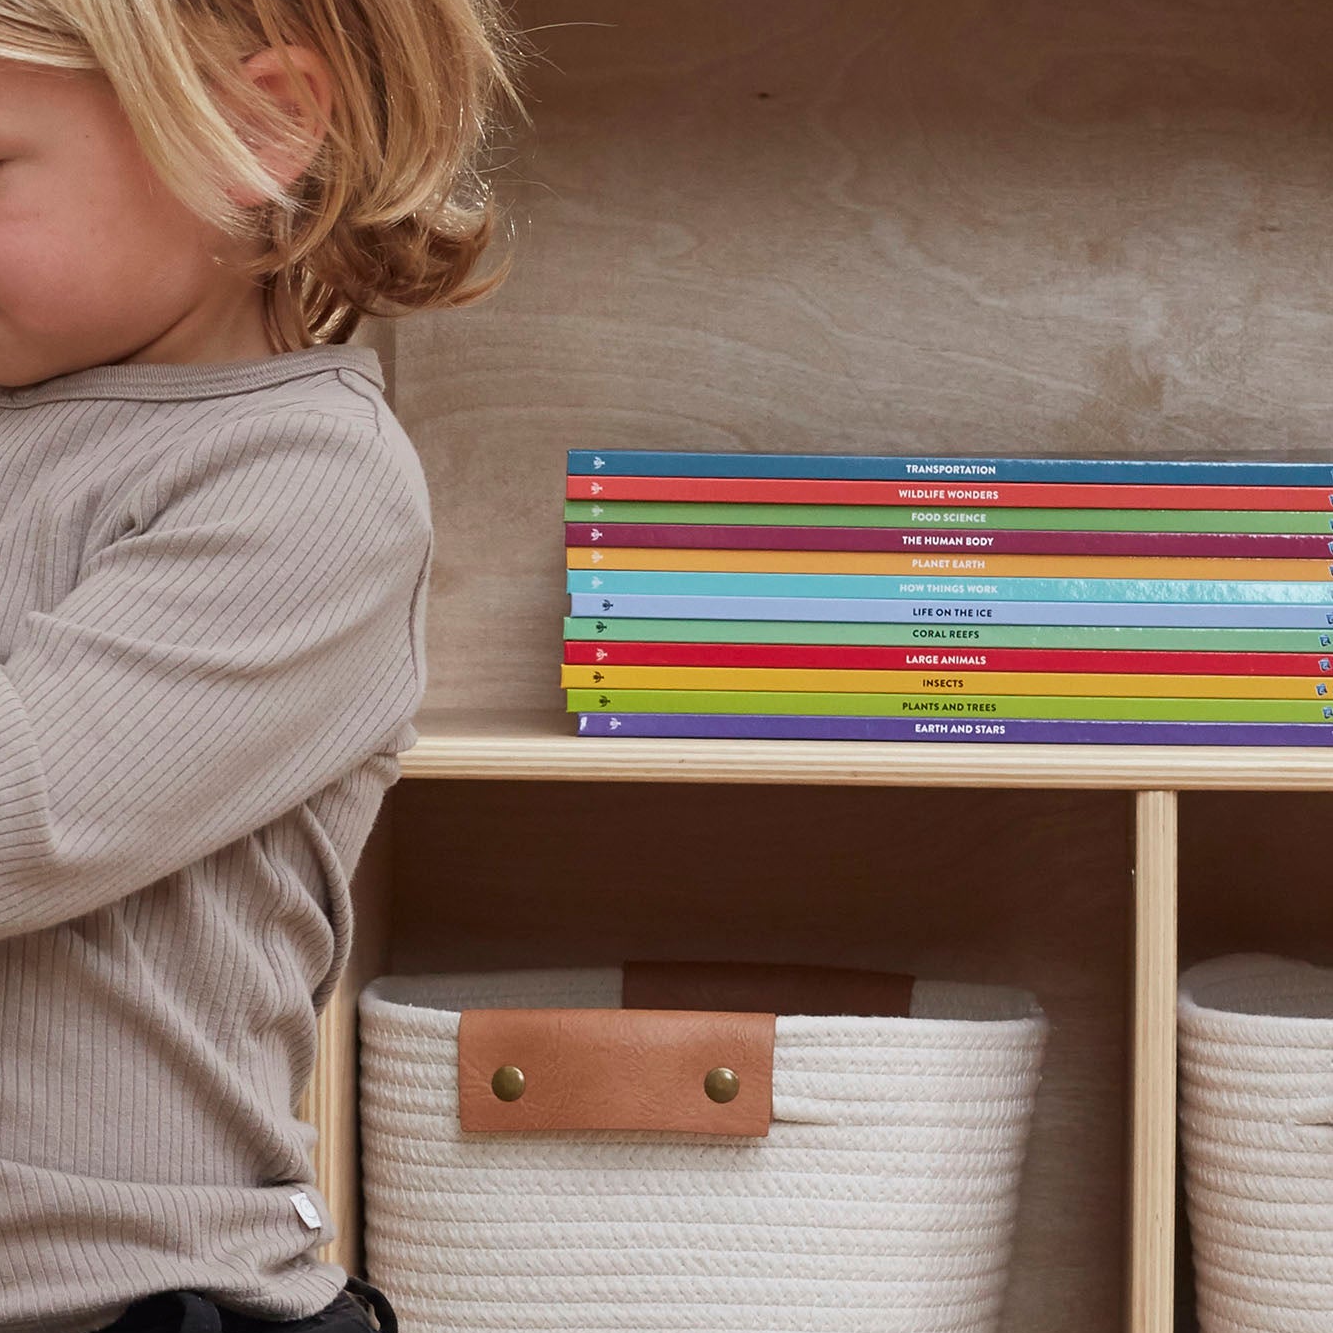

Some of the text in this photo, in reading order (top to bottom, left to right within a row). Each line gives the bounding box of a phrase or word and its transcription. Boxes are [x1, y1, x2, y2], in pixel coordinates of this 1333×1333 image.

[905, 463, 997, 475] TRANSPORTATION
[898, 488, 999, 500] WILDLIFE WONDERS
[911, 512, 987, 523] FOOD SCIENCE
[902, 535, 994, 547] THE HUMAN BODY
[911, 558, 985, 569] PLANET EARTH
[899, 583, 999, 594] HOW THINGS WORK
[912, 608, 993, 618] LIFE ON THE ICE
[912, 629, 980, 639] CORAL REEFS
[905, 654, 987, 665] LARGE ANIMALS
[922, 679, 964, 688] INSECTS
[902, 702, 997, 712] PLANTS AND TREES
[915, 723, 1006, 735] EARTH AND STARS
